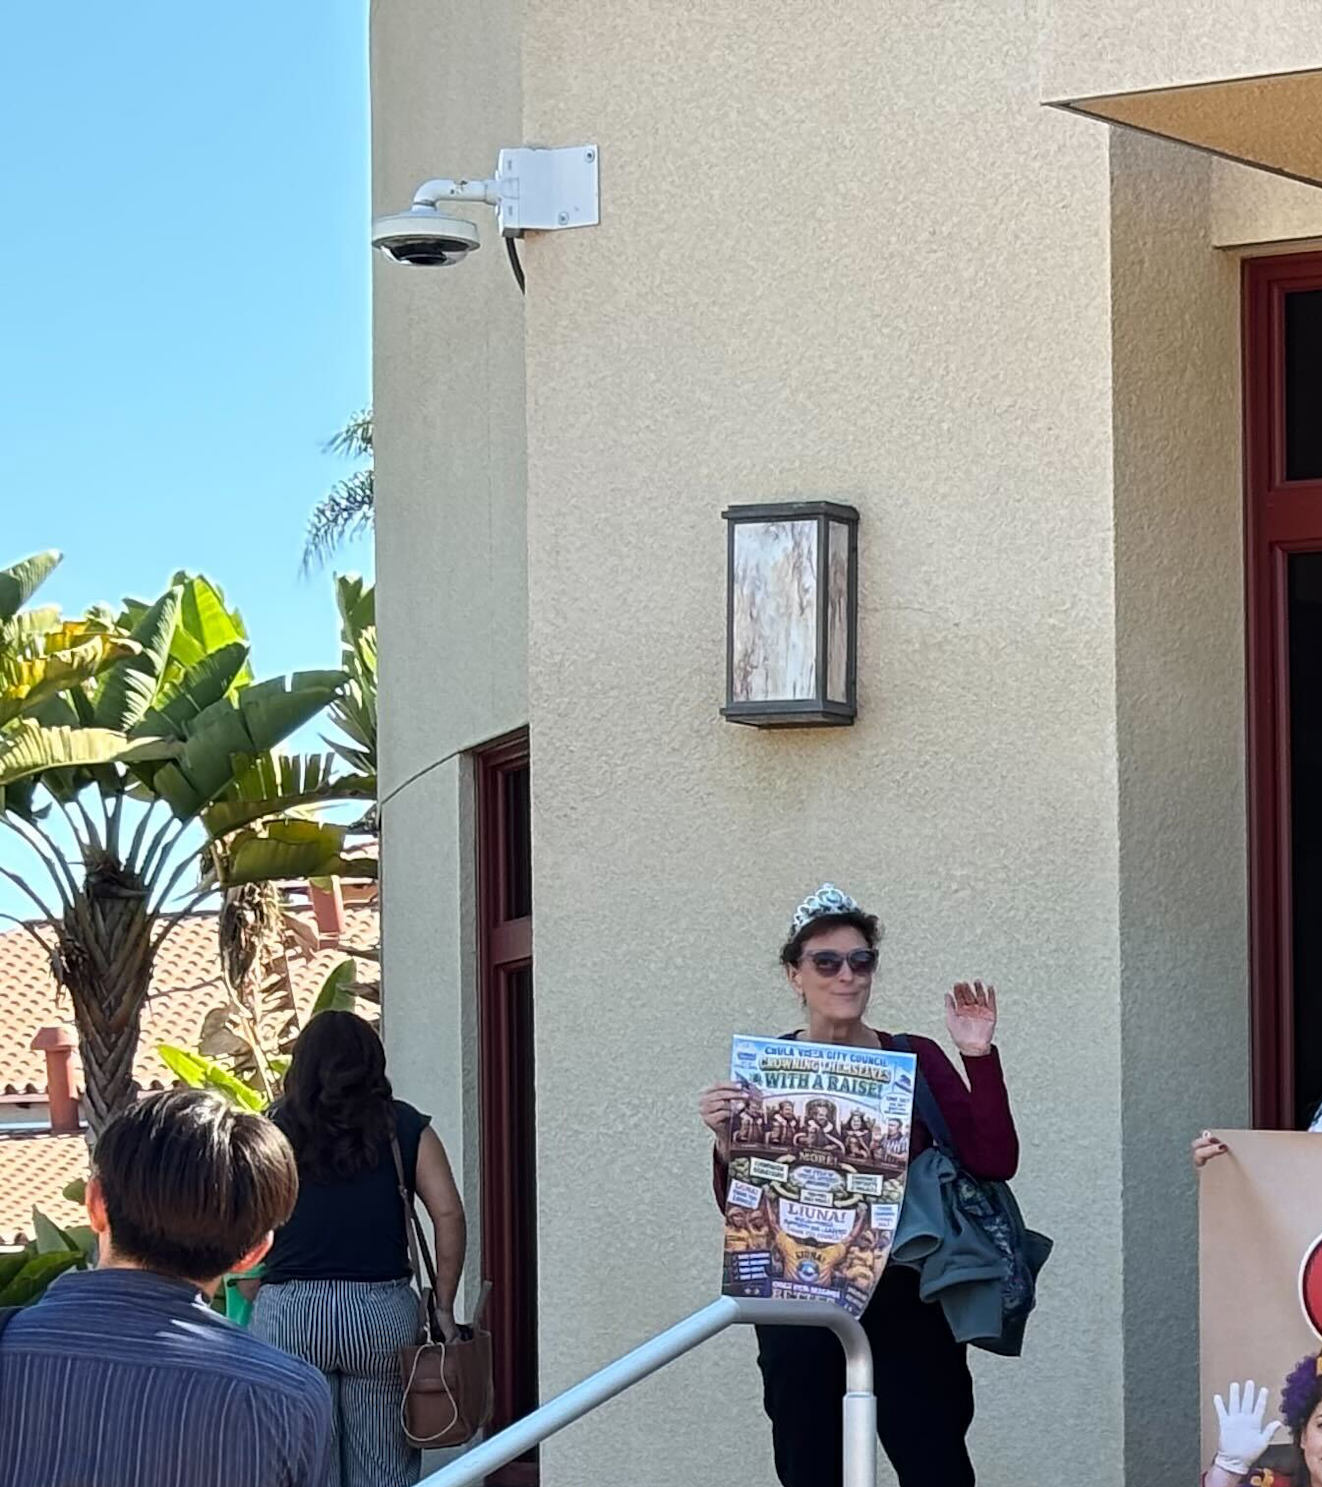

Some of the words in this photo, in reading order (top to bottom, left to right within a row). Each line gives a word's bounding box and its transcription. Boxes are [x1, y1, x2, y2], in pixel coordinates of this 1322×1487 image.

[827, 1050, 847, 1061] CITY
[850, 1055, 888, 1068] COUNCIL
[764, 1072, 809, 1090] WITH
[812, 1075, 824, 1090] A
[827, 1076, 882, 1099] RAISE!
[800, 1152, 838, 1166] MORE!
[788, 1203, 846, 1223] LIUNA!
